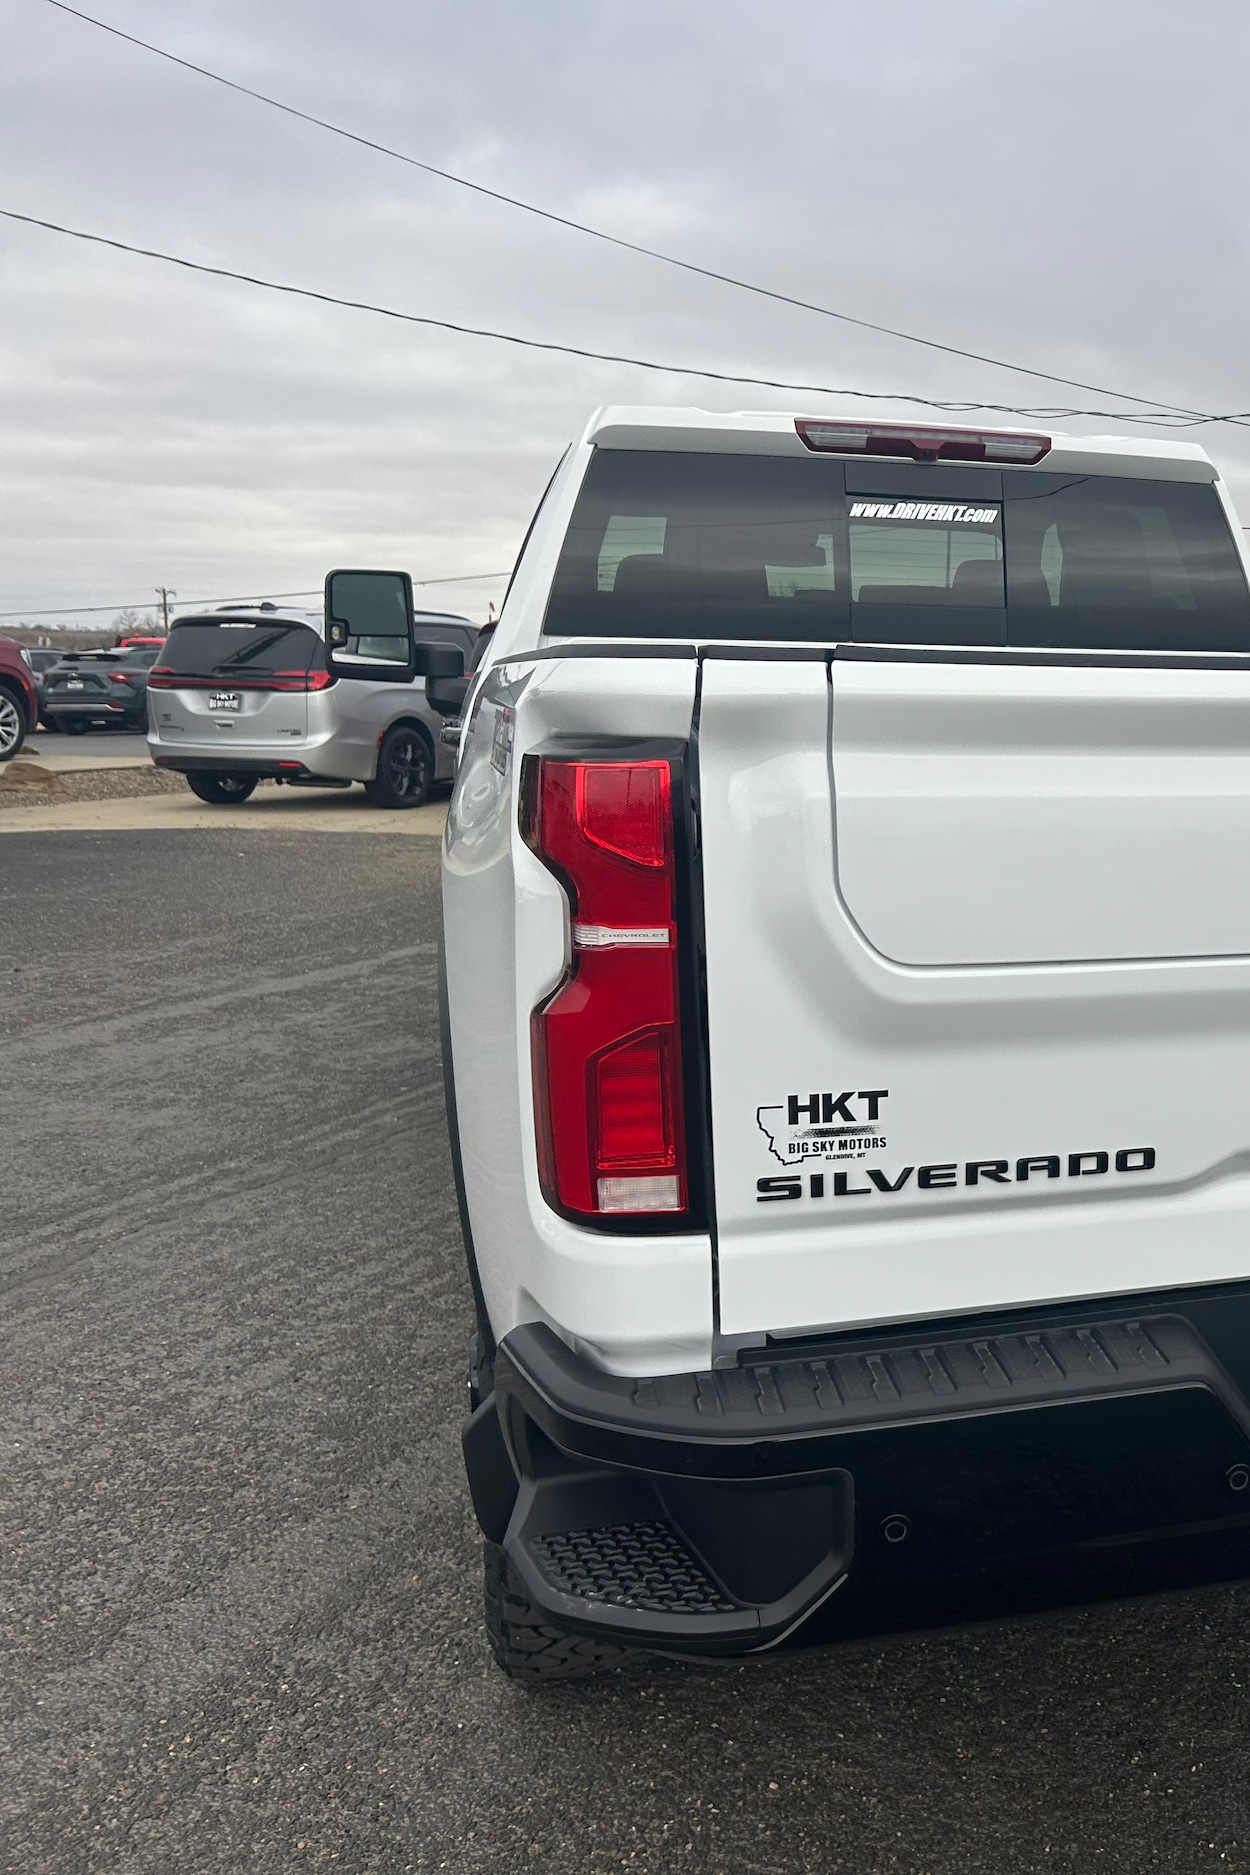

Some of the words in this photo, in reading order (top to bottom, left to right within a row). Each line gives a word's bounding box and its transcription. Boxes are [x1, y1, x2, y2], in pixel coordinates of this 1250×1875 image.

[849, 502, 999, 524] www.DRIVEHKT.com
[787, 1089, 889, 1125] HKT
[788, 1142, 809, 1154] BIG
[812, 1140, 836, 1152] SKY
[838, 1137, 887, 1151] MOTORS
[756, 1147, 1156, 1202] SILVERADO
